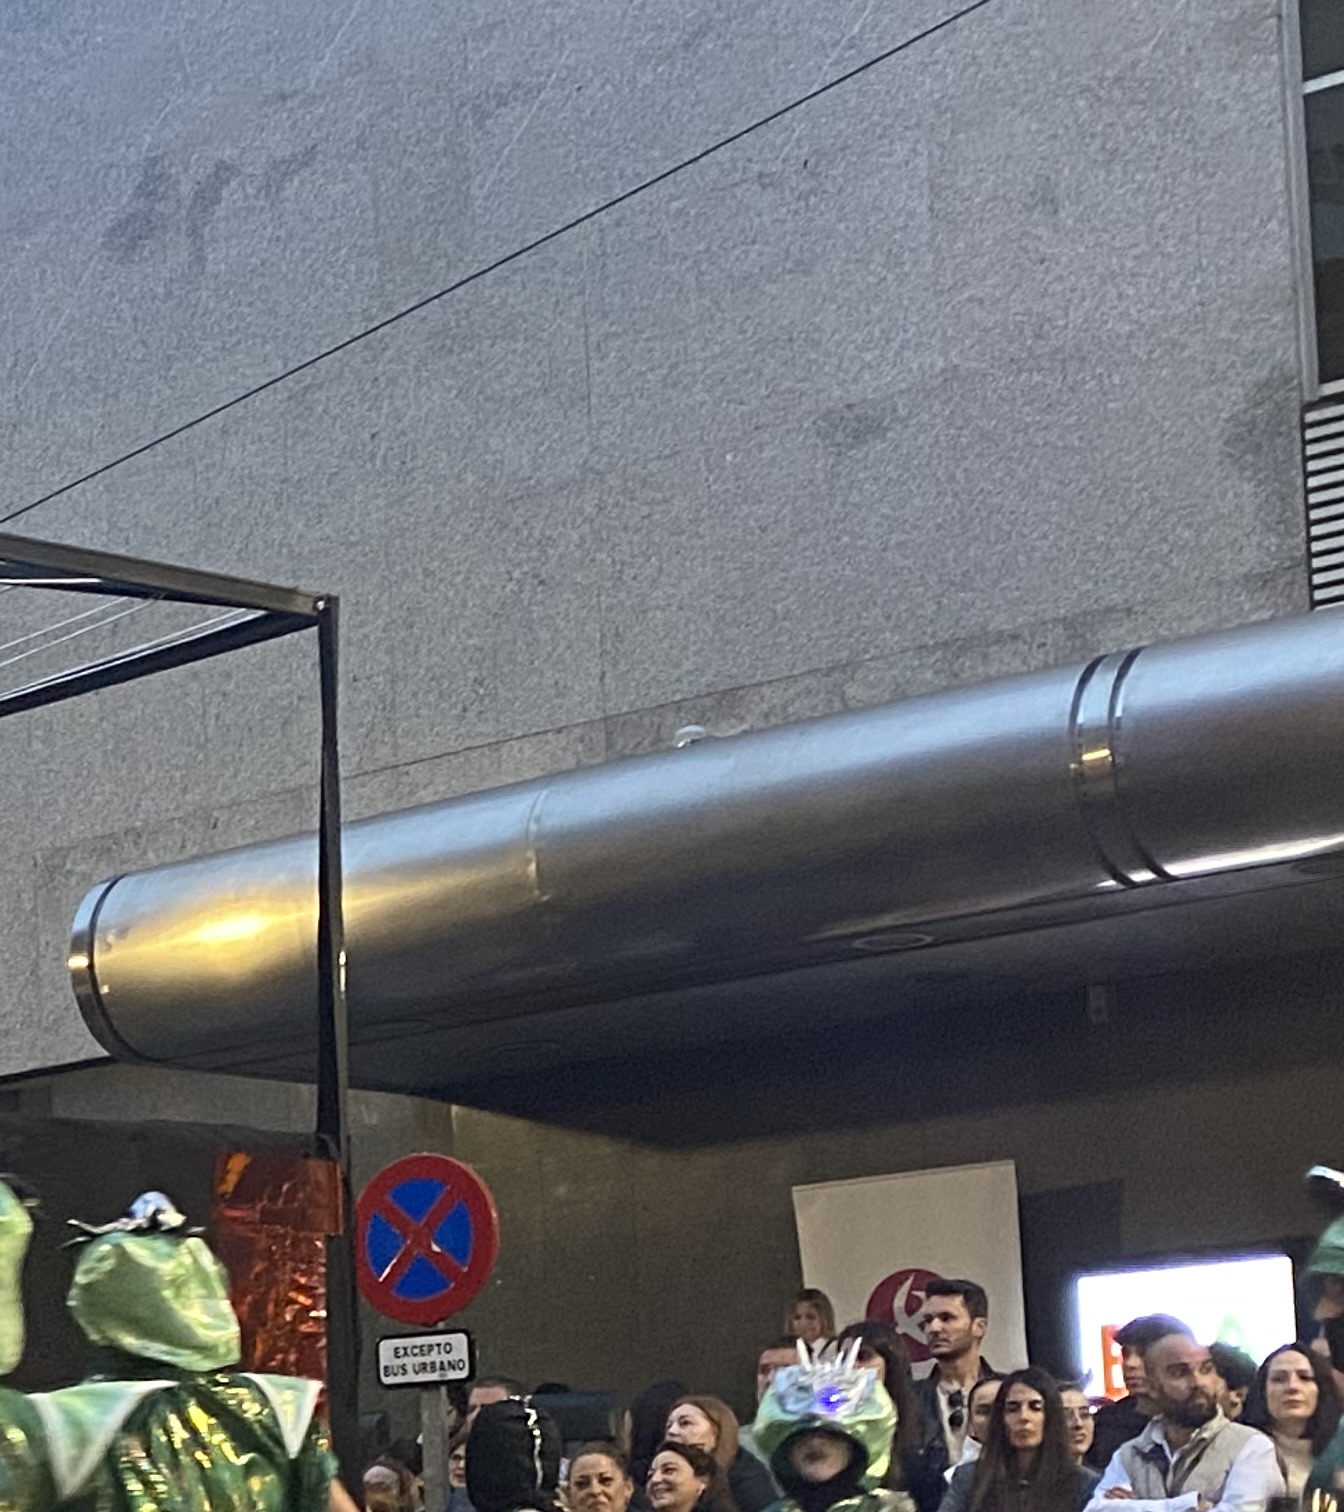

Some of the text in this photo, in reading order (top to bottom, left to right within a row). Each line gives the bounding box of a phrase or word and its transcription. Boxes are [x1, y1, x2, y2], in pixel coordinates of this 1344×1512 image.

[393, 1342, 453, 1359] EXCEPTO
[383, 1358, 466, 1378] BUS URBANO
